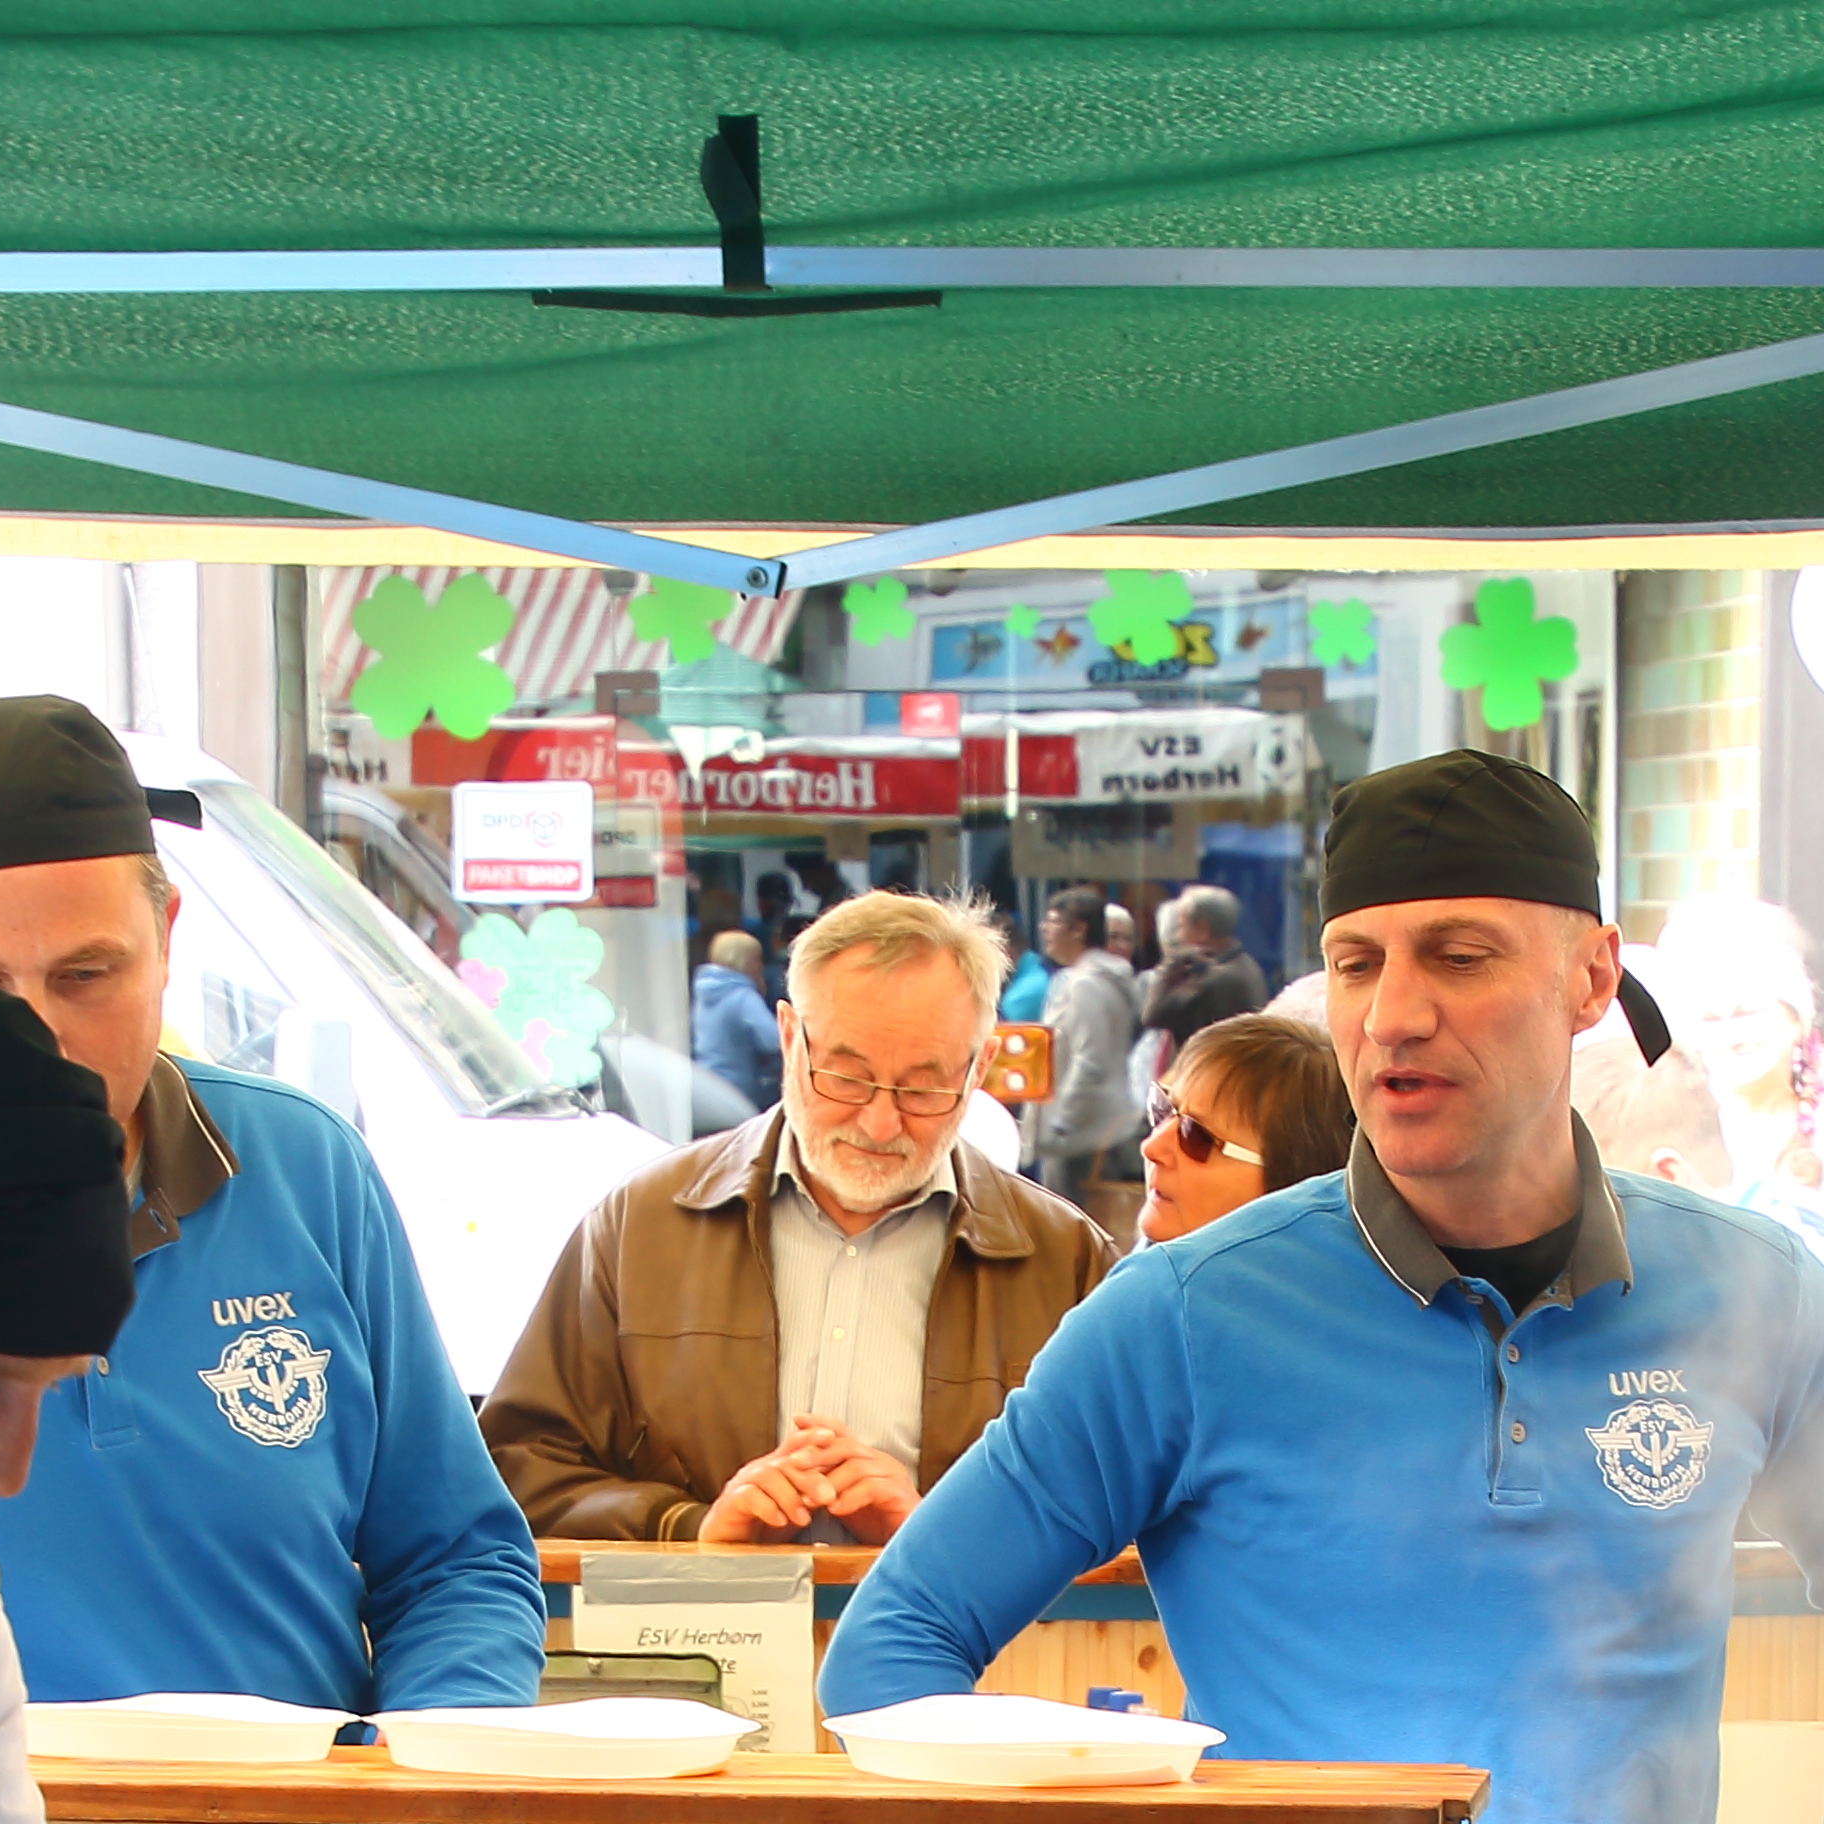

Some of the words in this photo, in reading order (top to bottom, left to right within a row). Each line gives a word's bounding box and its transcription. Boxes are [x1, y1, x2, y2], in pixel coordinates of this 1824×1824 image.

[481, 813, 523, 828] DPD
[212, 1291, 297, 1327] uvex
[254, 1350, 283, 1367] ESV
[1608, 1369, 1688, 1396] uvex
[247, 1396, 313, 1426] HERBORN
[1639, 1419, 1667, 1434] ESV
[1625, 1463, 1692, 1489] HERBORN
[636, 1626, 680, 1647] ESV
[681, 1626, 764, 1647] Herborn
